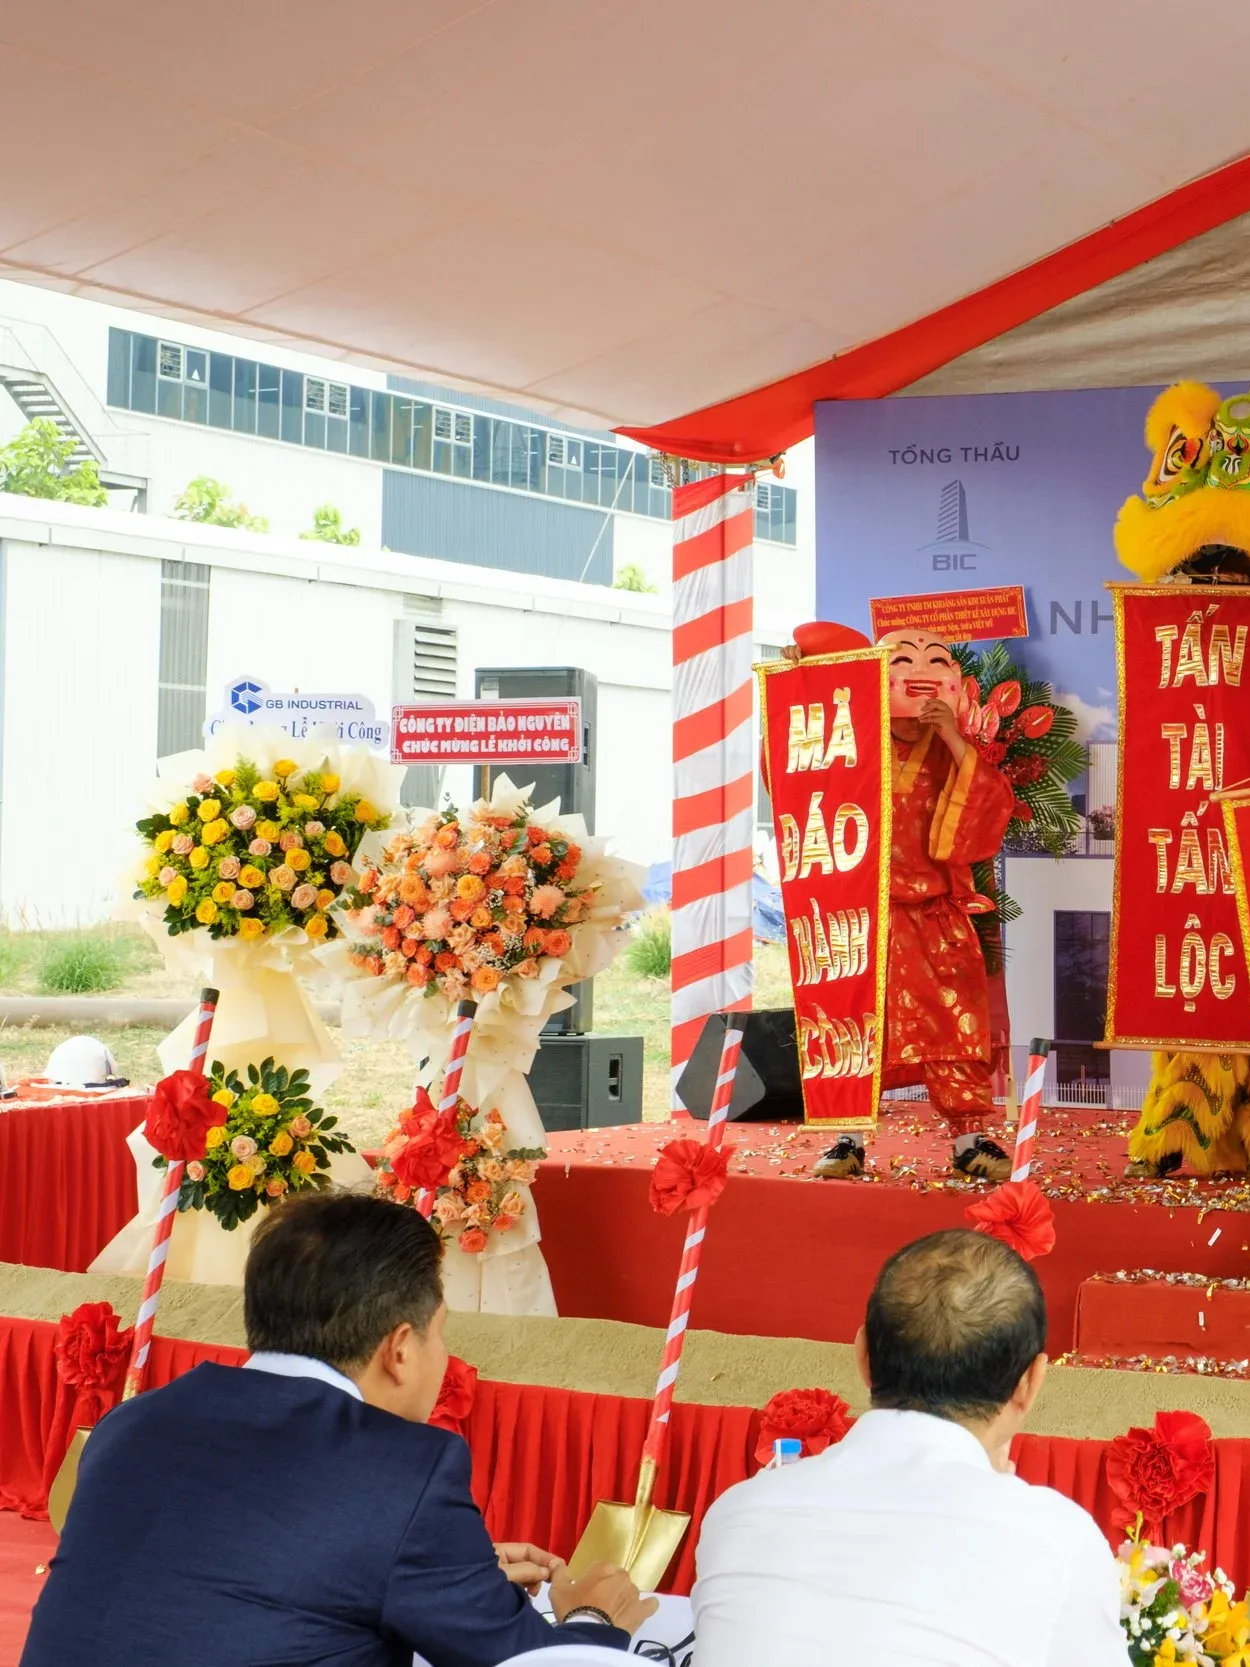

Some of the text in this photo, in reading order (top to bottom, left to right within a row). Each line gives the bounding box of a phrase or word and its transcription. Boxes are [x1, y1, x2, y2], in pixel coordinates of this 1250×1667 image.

[889, 444, 951, 464] TỔNG
[933, 554, 977, 571] BIC
[1050, 600, 1114, 634] NH
[1155, 604, 1248, 688] TẤN
[266, 700, 363, 710] GB INDUSTRIAL
[349, 721, 382, 743] Công
[400, 711, 570, 735] CÔNG TY ĐIỆN BẢO NGUYÊN
[786, 687, 857, 774] MÃ
[403, 734, 569, 753] CHÚC MỪNG LỄ KHỞI CÔNG
[1161, 704, 1225, 790] TÀI
[779, 792, 869, 883] ĐÁO
[1148, 800, 1236, 895] TẤN
[790, 898, 869, 987] THÀNH
[1154, 913, 1236, 1012] LỘC
